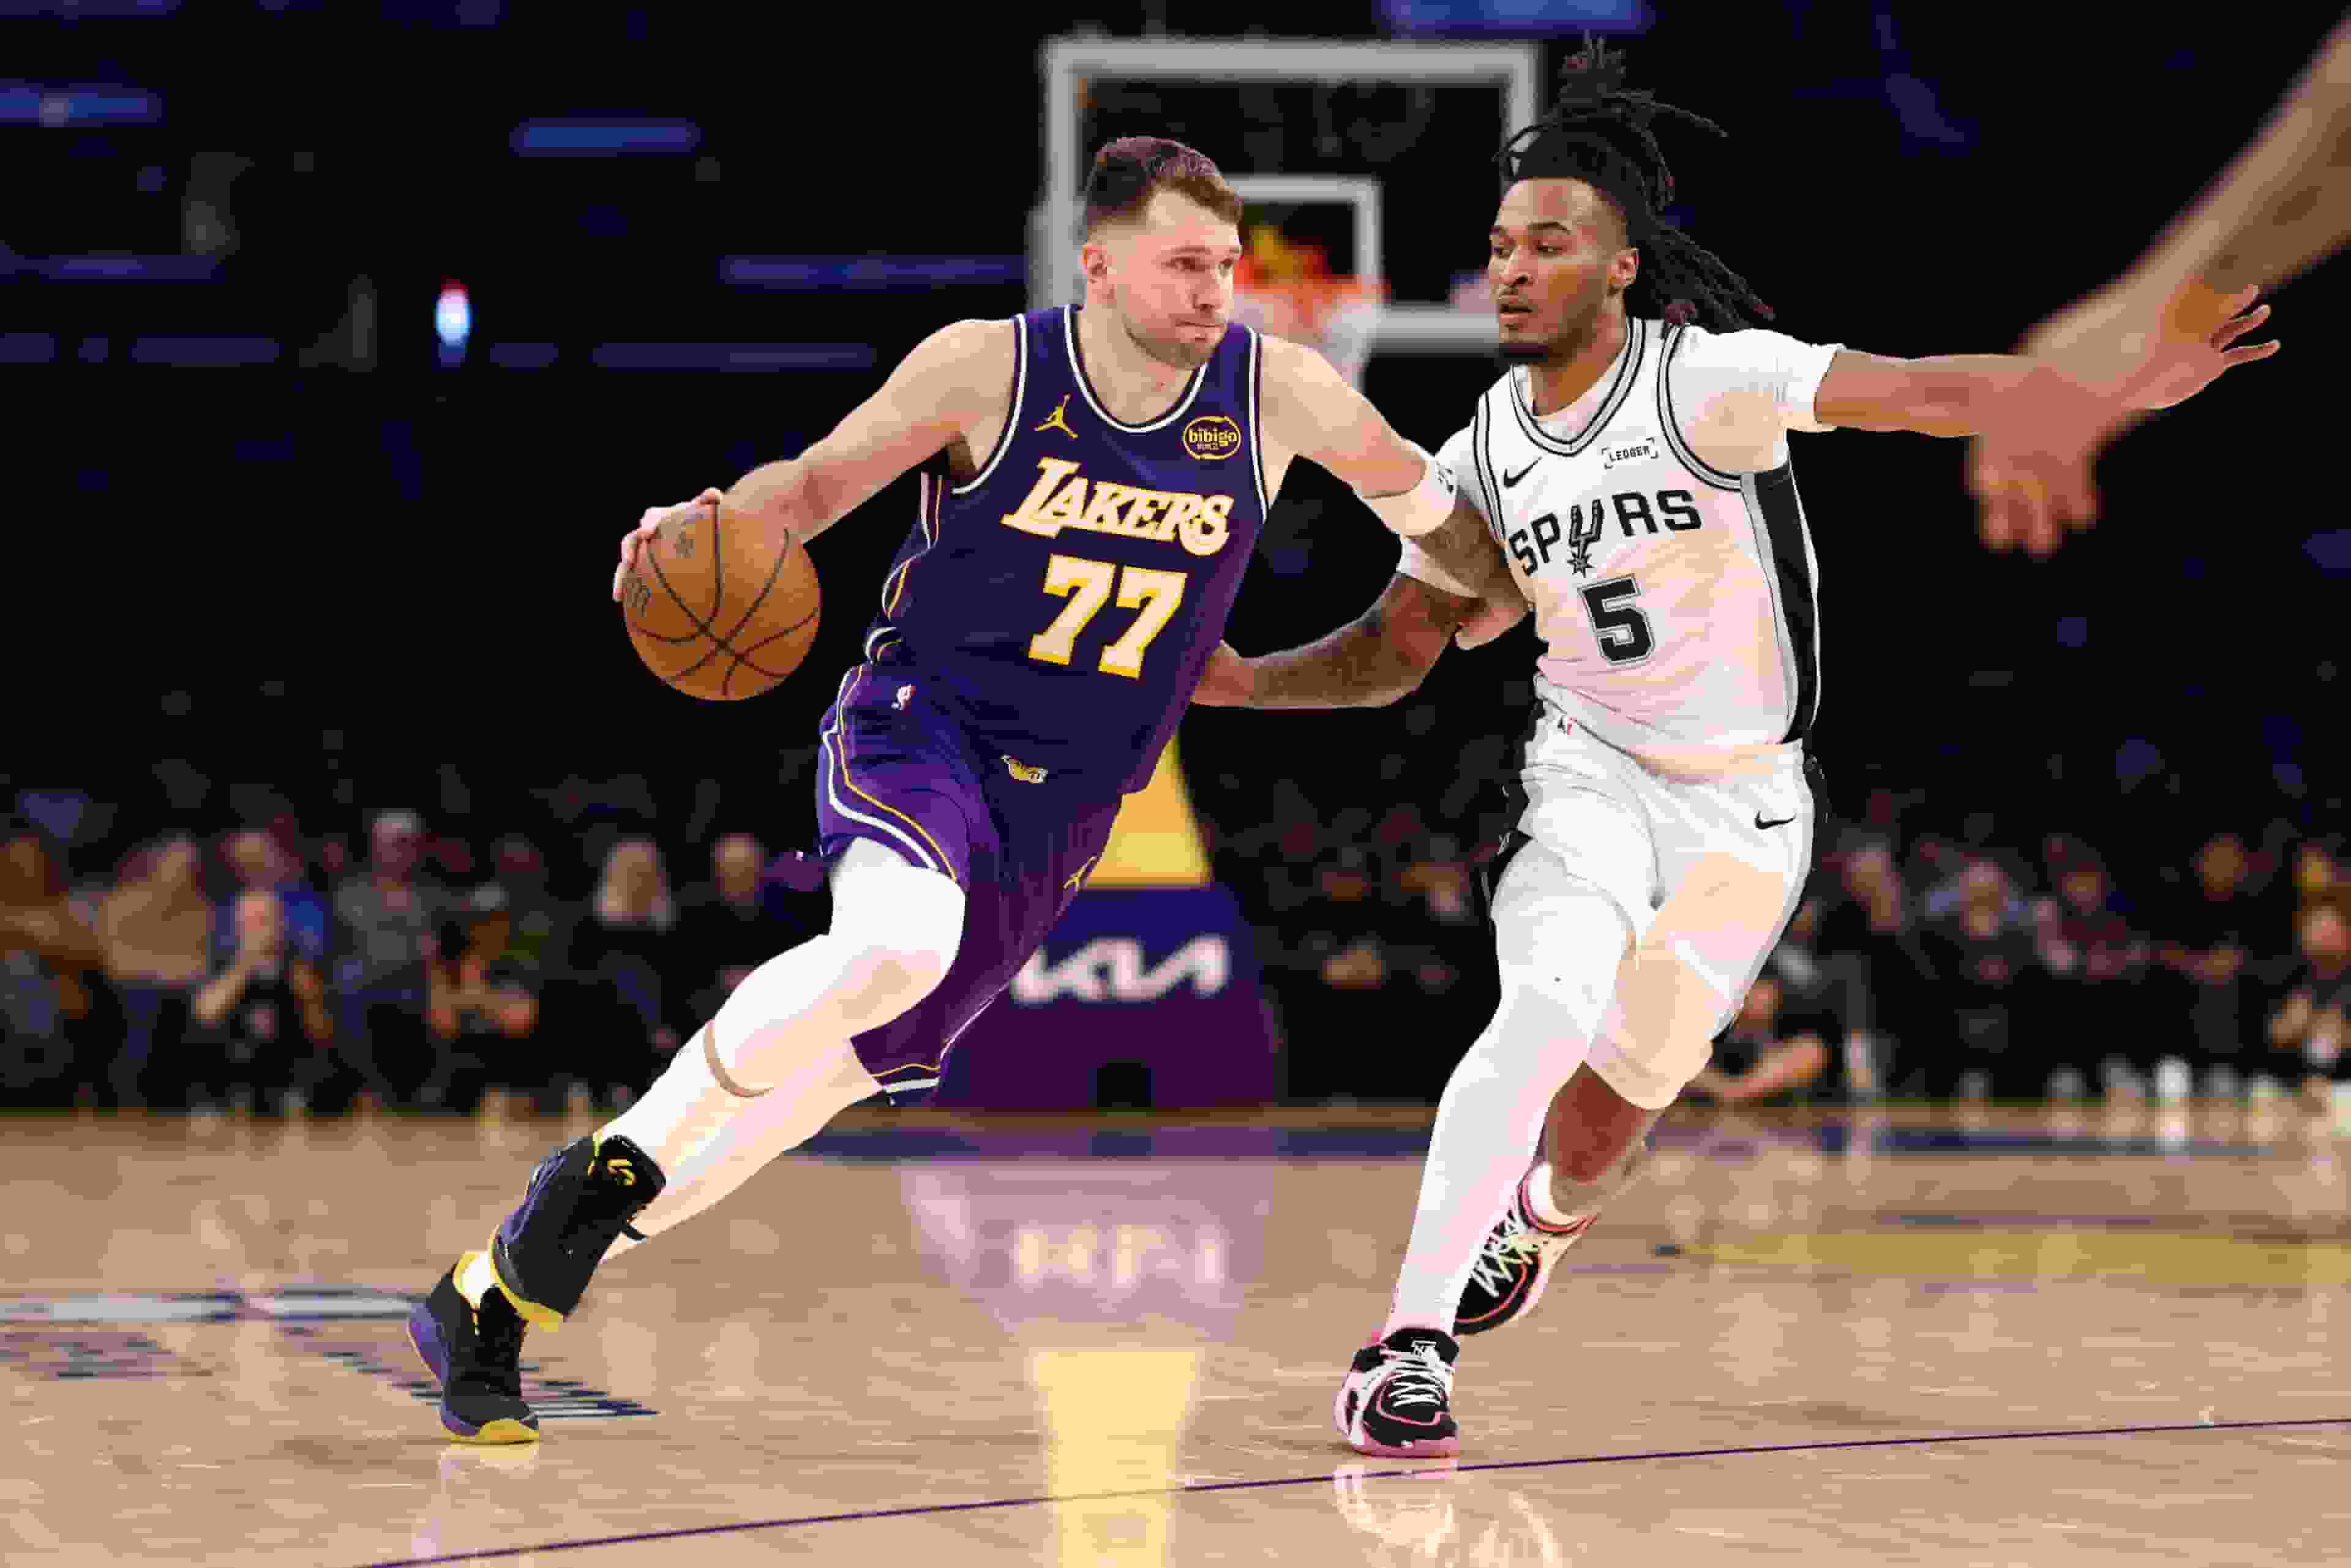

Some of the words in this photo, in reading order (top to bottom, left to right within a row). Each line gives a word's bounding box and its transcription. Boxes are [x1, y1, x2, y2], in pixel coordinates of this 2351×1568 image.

[1188, 427, 1237, 446] bibigo
[1608, 445, 1651, 462] LEDGER
[1000, 456, 1235, 556] LAKERS
[1508, 489, 1702, 577] SPURS
[1028, 553, 1188, 680] 77
[1577, 573, 1655, 666] 5
